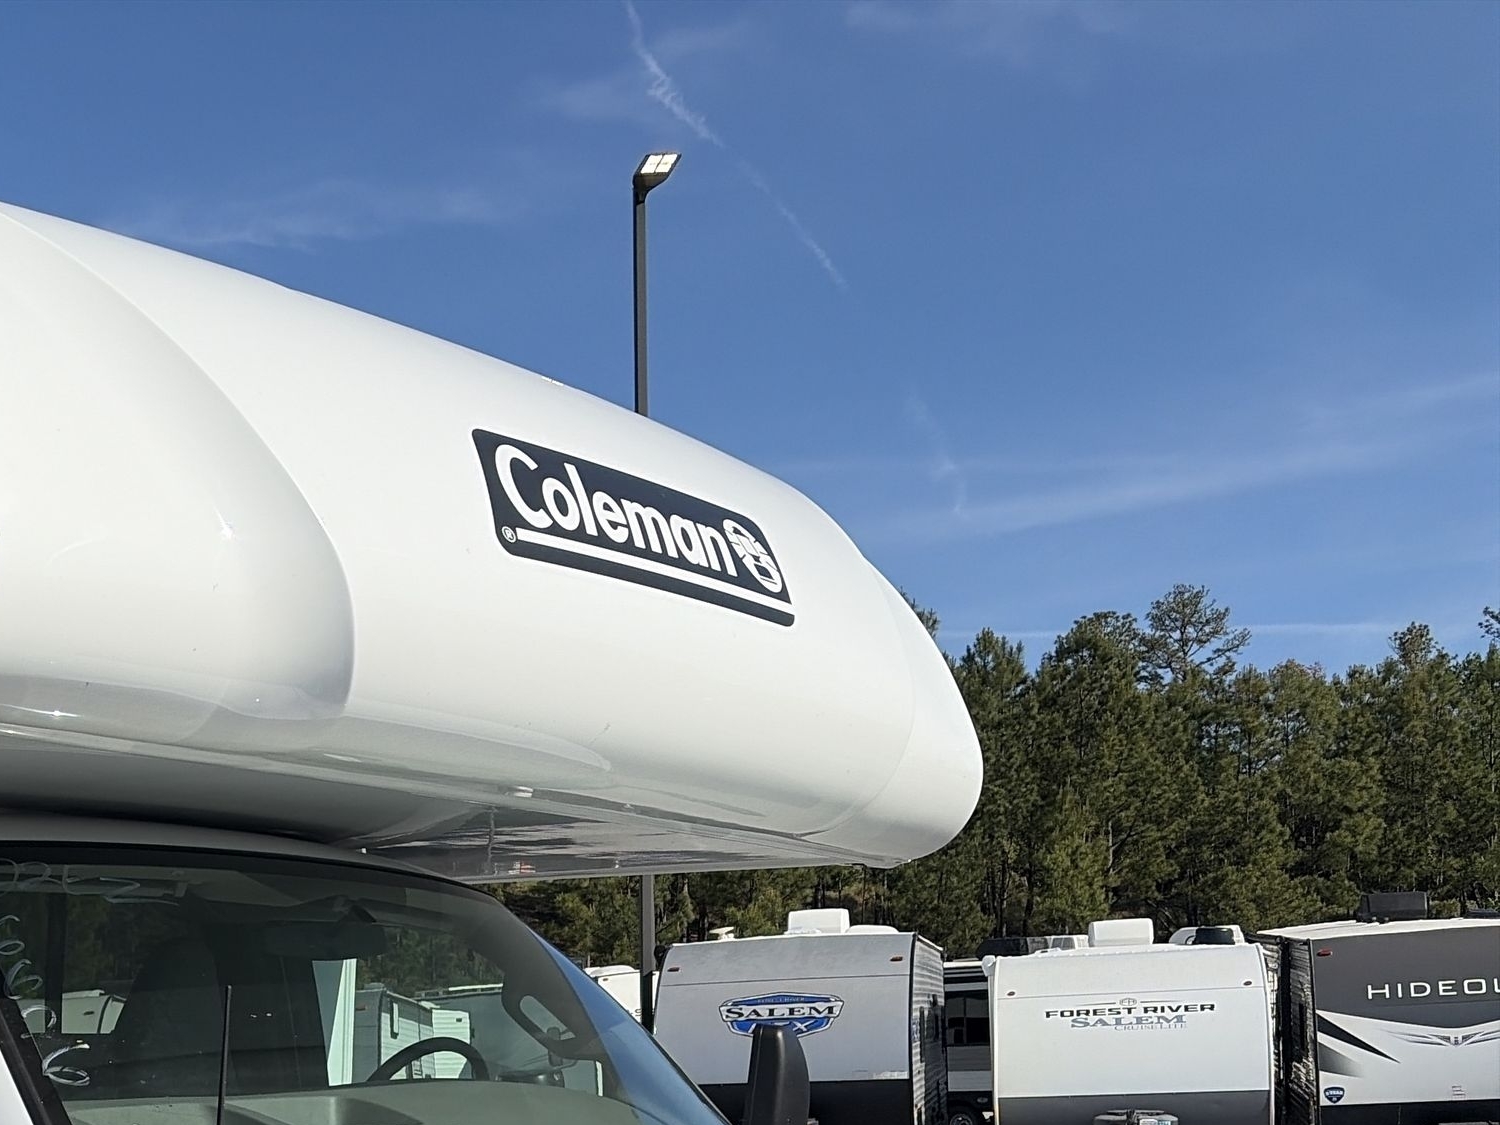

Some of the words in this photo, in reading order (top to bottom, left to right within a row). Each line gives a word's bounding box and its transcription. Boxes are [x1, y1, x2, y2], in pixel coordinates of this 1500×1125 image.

[494, 443, 738, 578] Coleman
[725, 1005, 837, 1019] SALEM
[1044, 1006, 1137, 1019] FOREST
[1143, 1003, 1216, 1014] RIVER
[1070, 1014, 1187, 1029] SALEM
